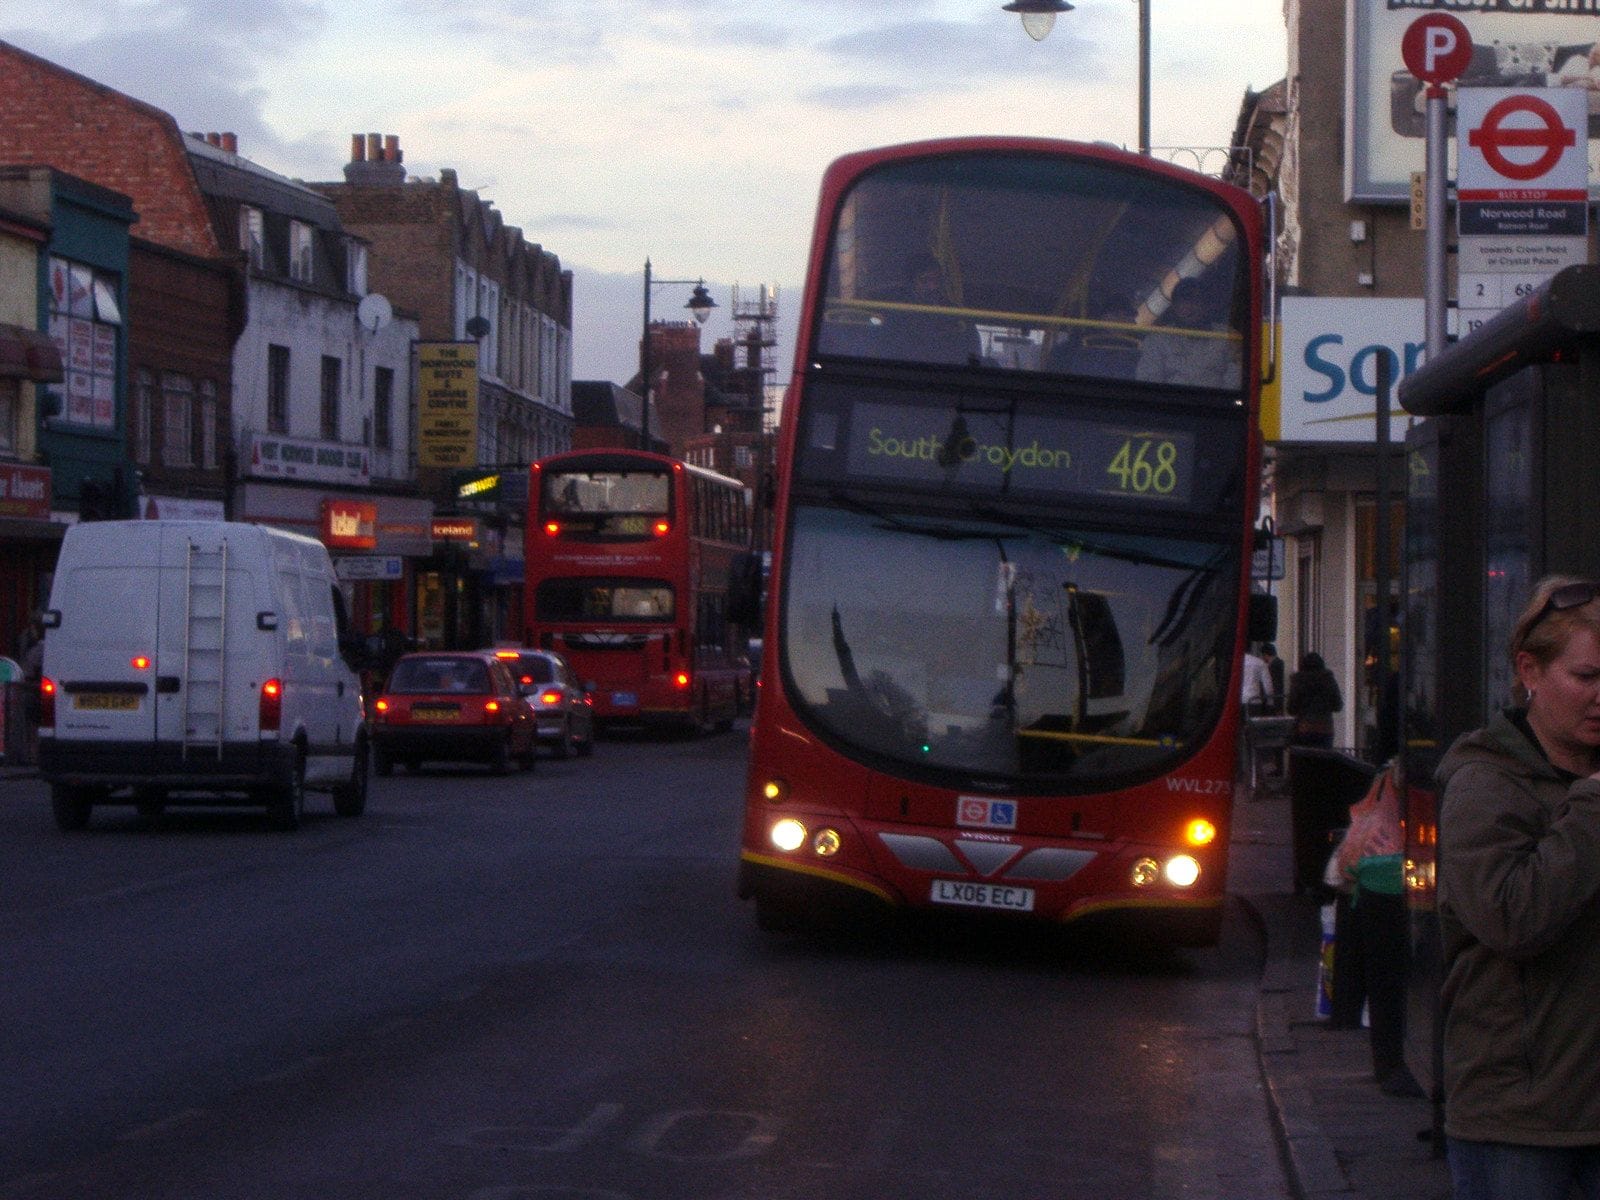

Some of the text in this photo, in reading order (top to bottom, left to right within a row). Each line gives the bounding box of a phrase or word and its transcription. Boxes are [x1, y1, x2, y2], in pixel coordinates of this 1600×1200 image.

[1425, 26, 1457, 72] P
[1498, 189, 1548, 200] BUS STOP
[1480, 207, 1567, 220] Norwood Road
[1499, 256, 1531, 266] Crystal
[1476, 283, 1534, 297] 2 68
[868, 427, 1072, 473] South Croydon
[1107, 439, 1178, 494] 468
[939, 882, 1029, 908] LX06 ECJ
